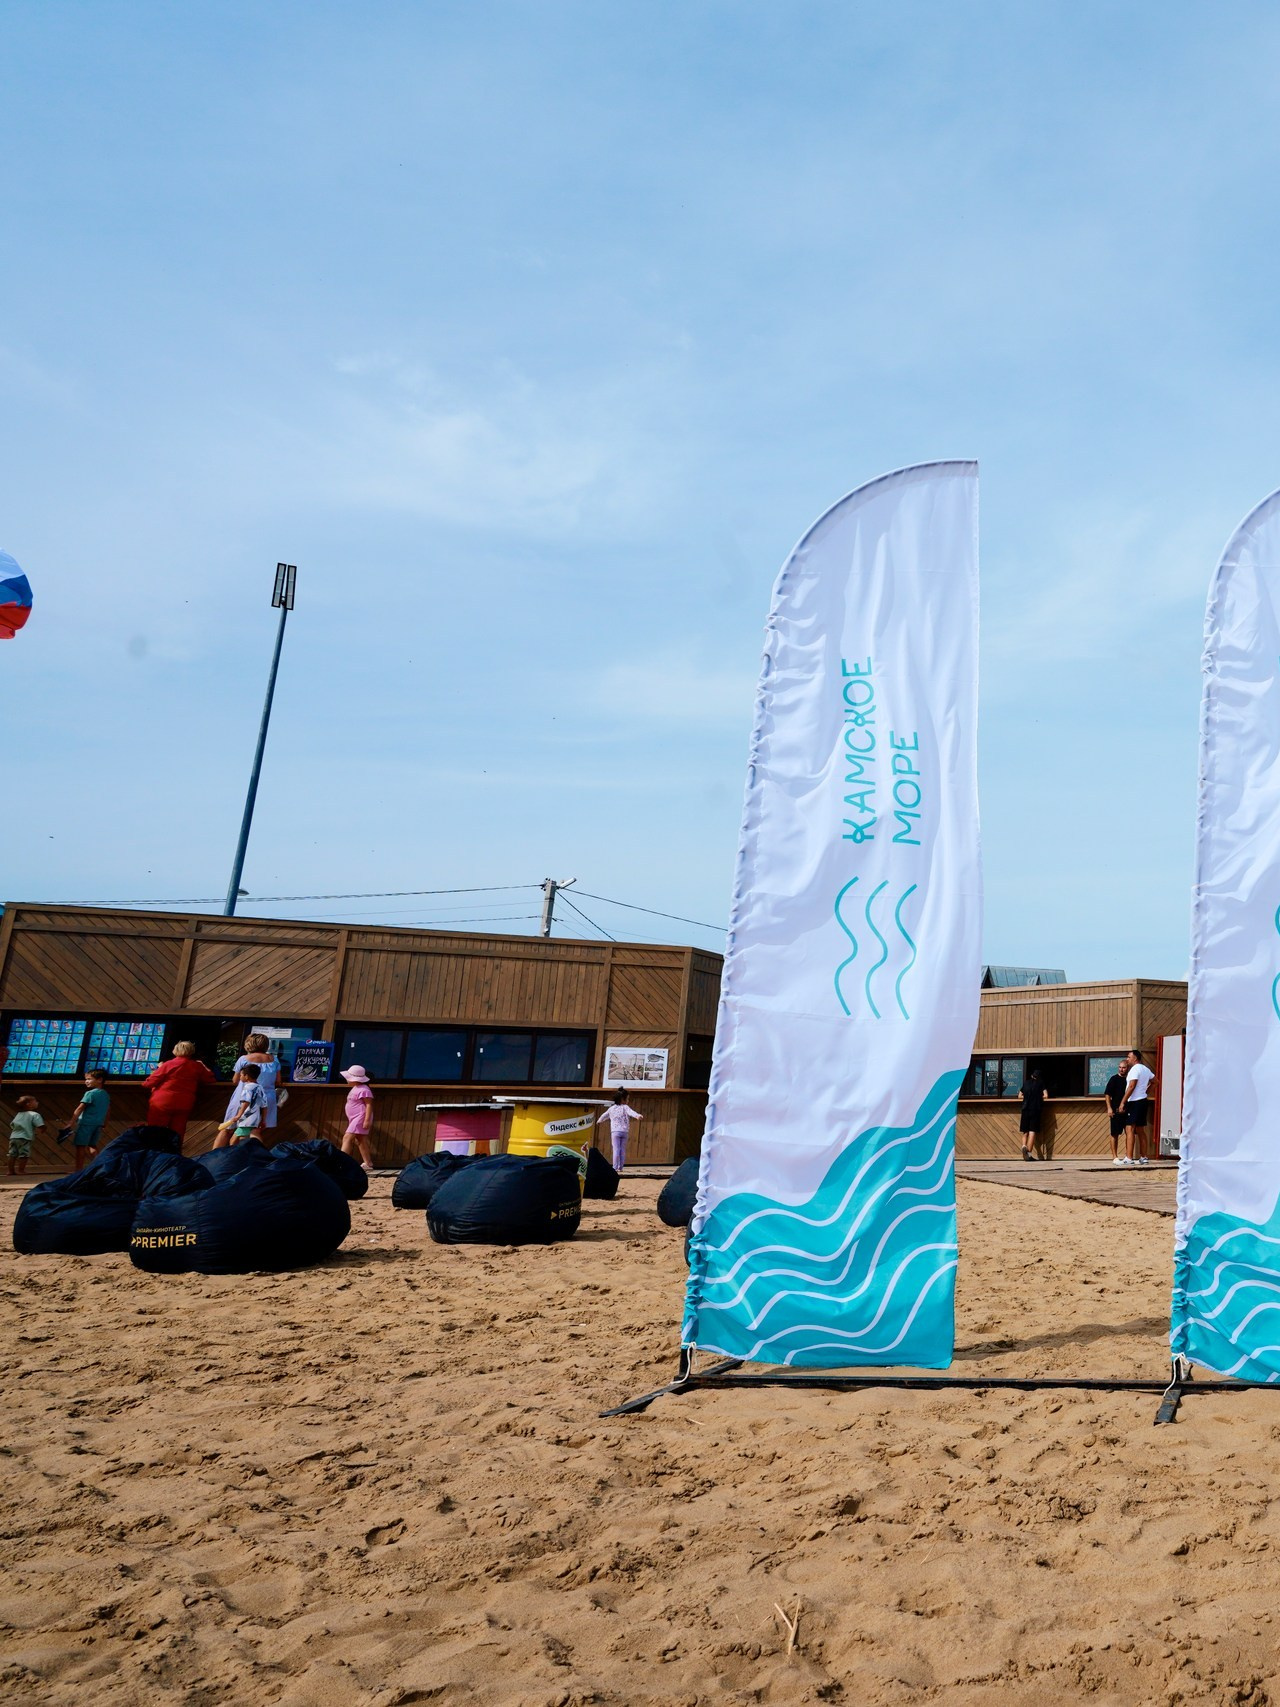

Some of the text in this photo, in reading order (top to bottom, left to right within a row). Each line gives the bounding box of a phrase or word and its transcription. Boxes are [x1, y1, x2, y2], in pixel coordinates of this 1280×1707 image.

[841, 656, 877, 844] КАМСКОЕ
[889, 730, 921, 845] МОРЕ
[297, 1048, 325, 1056] ГОРЯЧАЯ
[549, 1122, 578, 1132] Яндекс
[135, 1233, 197, 1249] PREMIER
